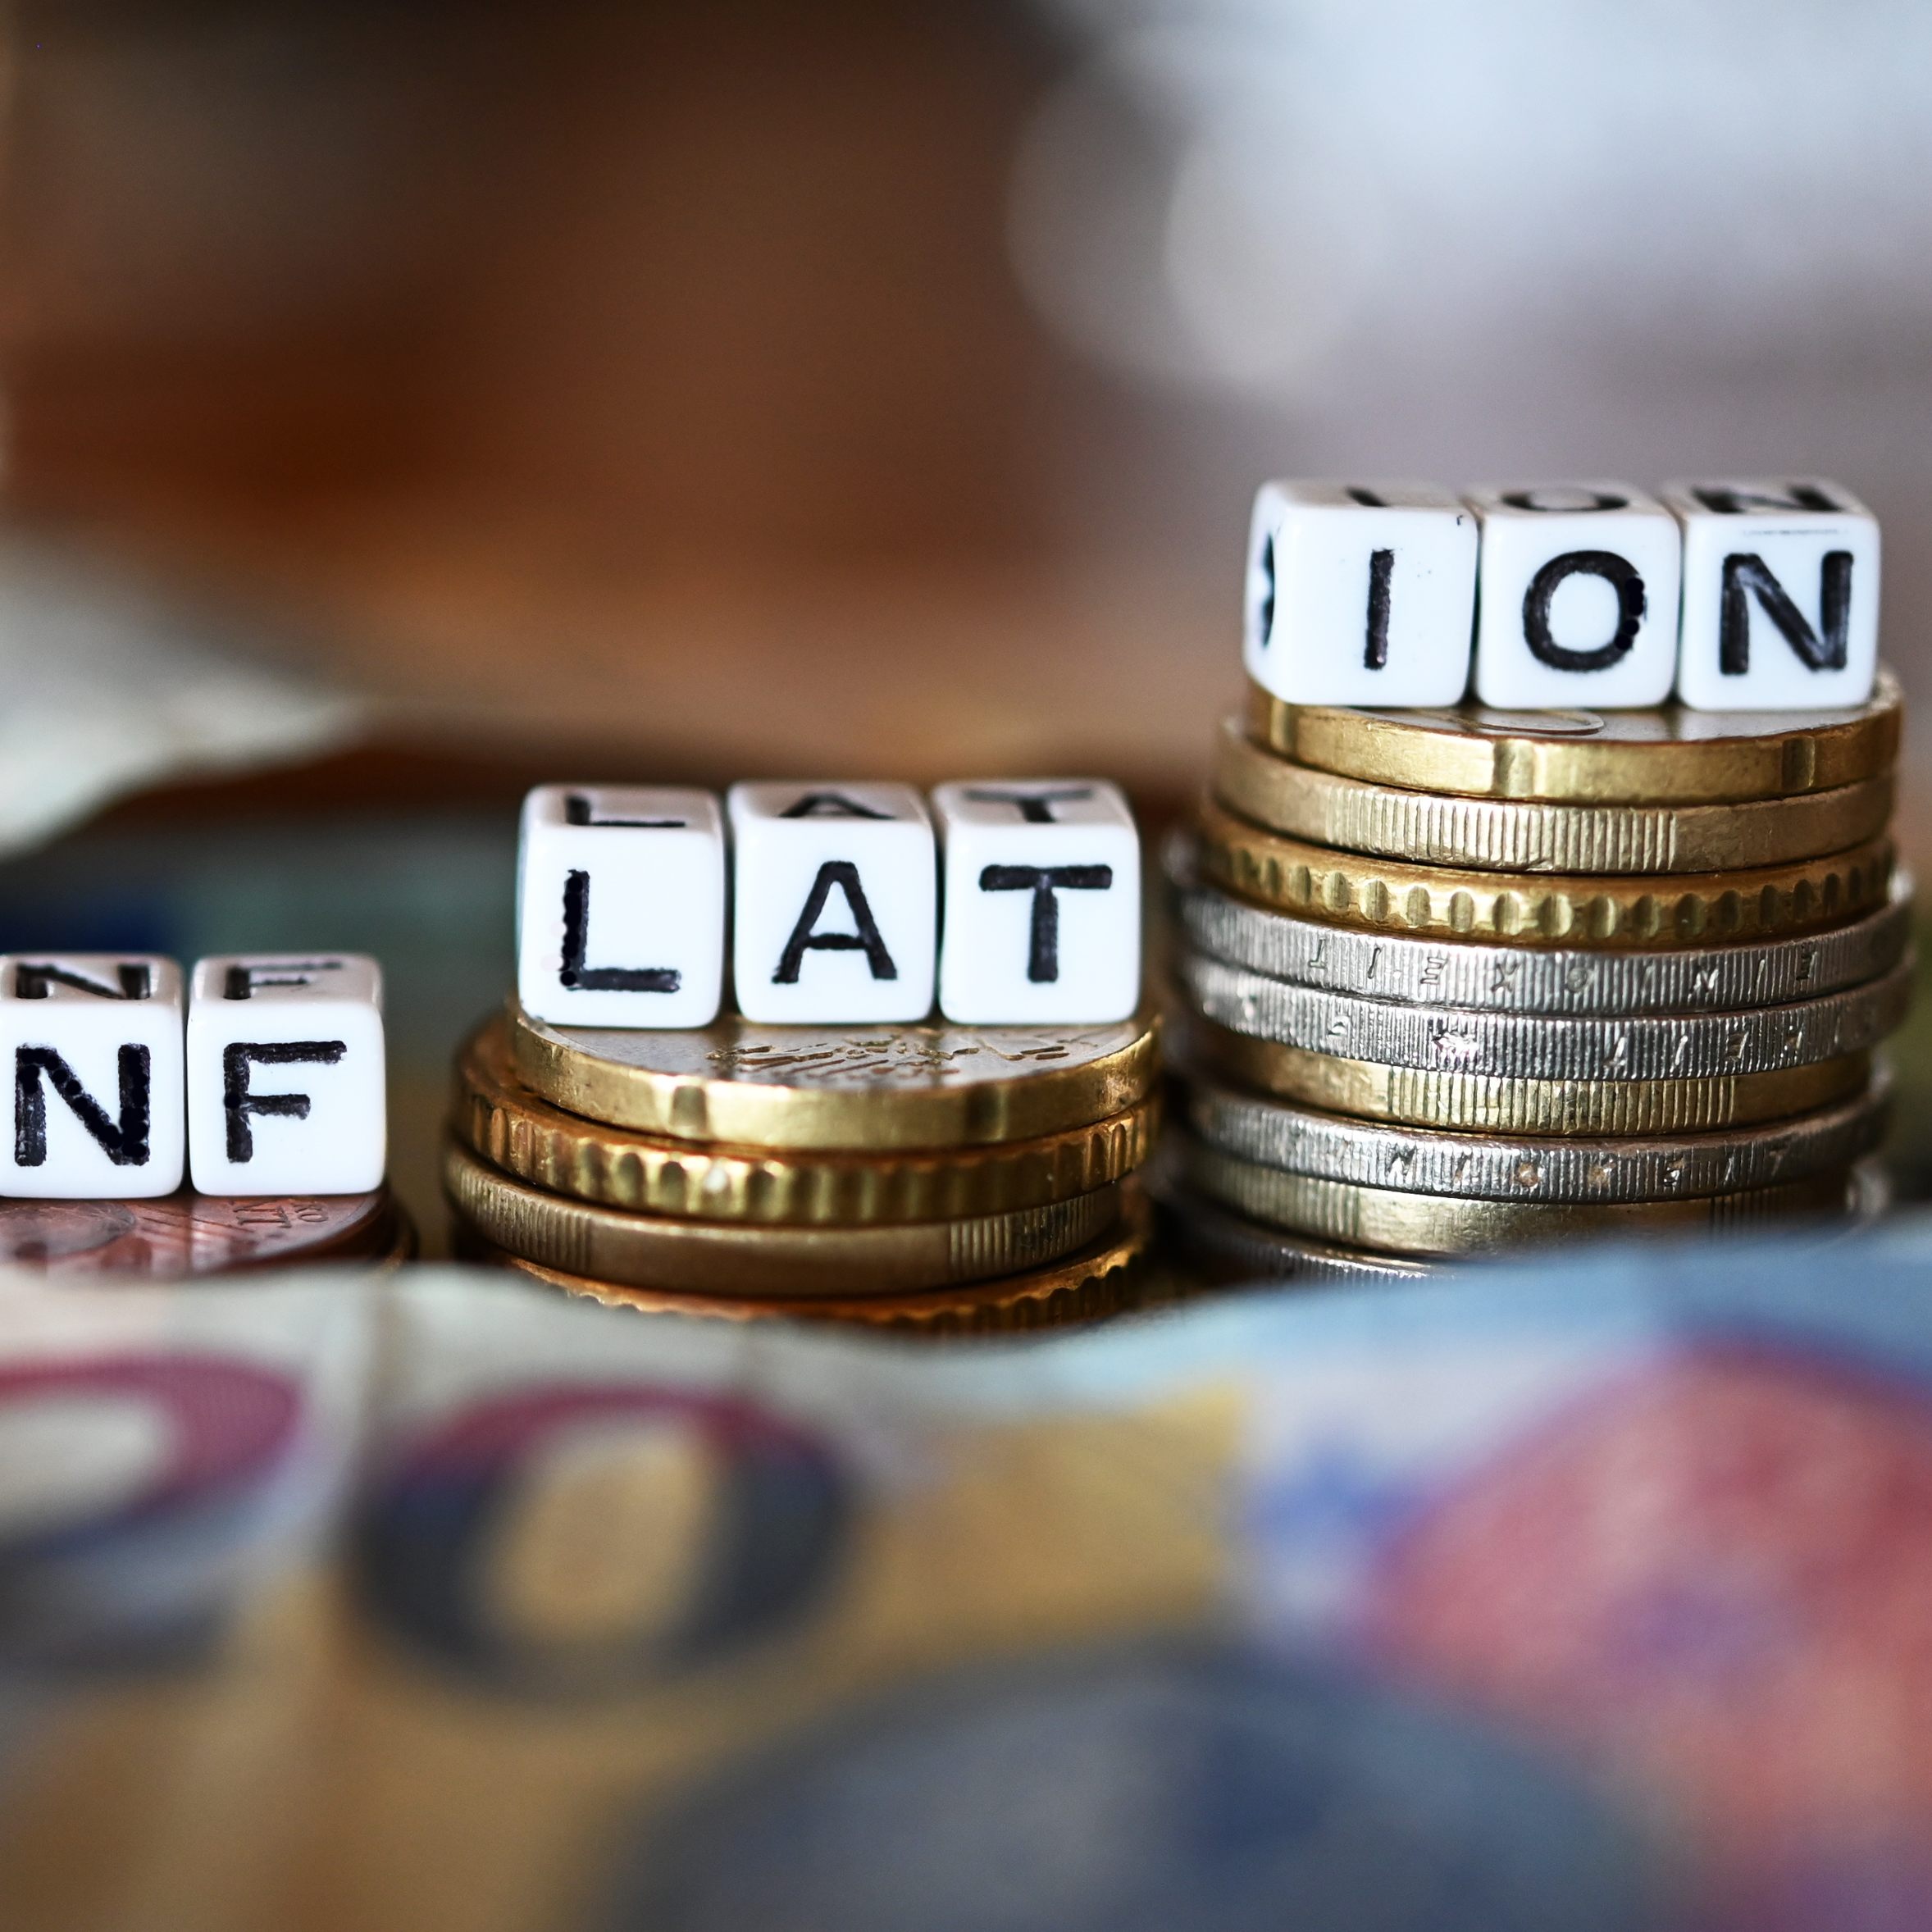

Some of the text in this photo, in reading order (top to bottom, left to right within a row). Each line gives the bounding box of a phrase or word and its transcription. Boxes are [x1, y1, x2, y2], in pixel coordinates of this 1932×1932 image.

[1363, 549, 1855, 676] ION
[14, 962, 343, 1001] NF
[558, 859, 1114, 995] LAT
[13, 1040, 348, 1168] NF
